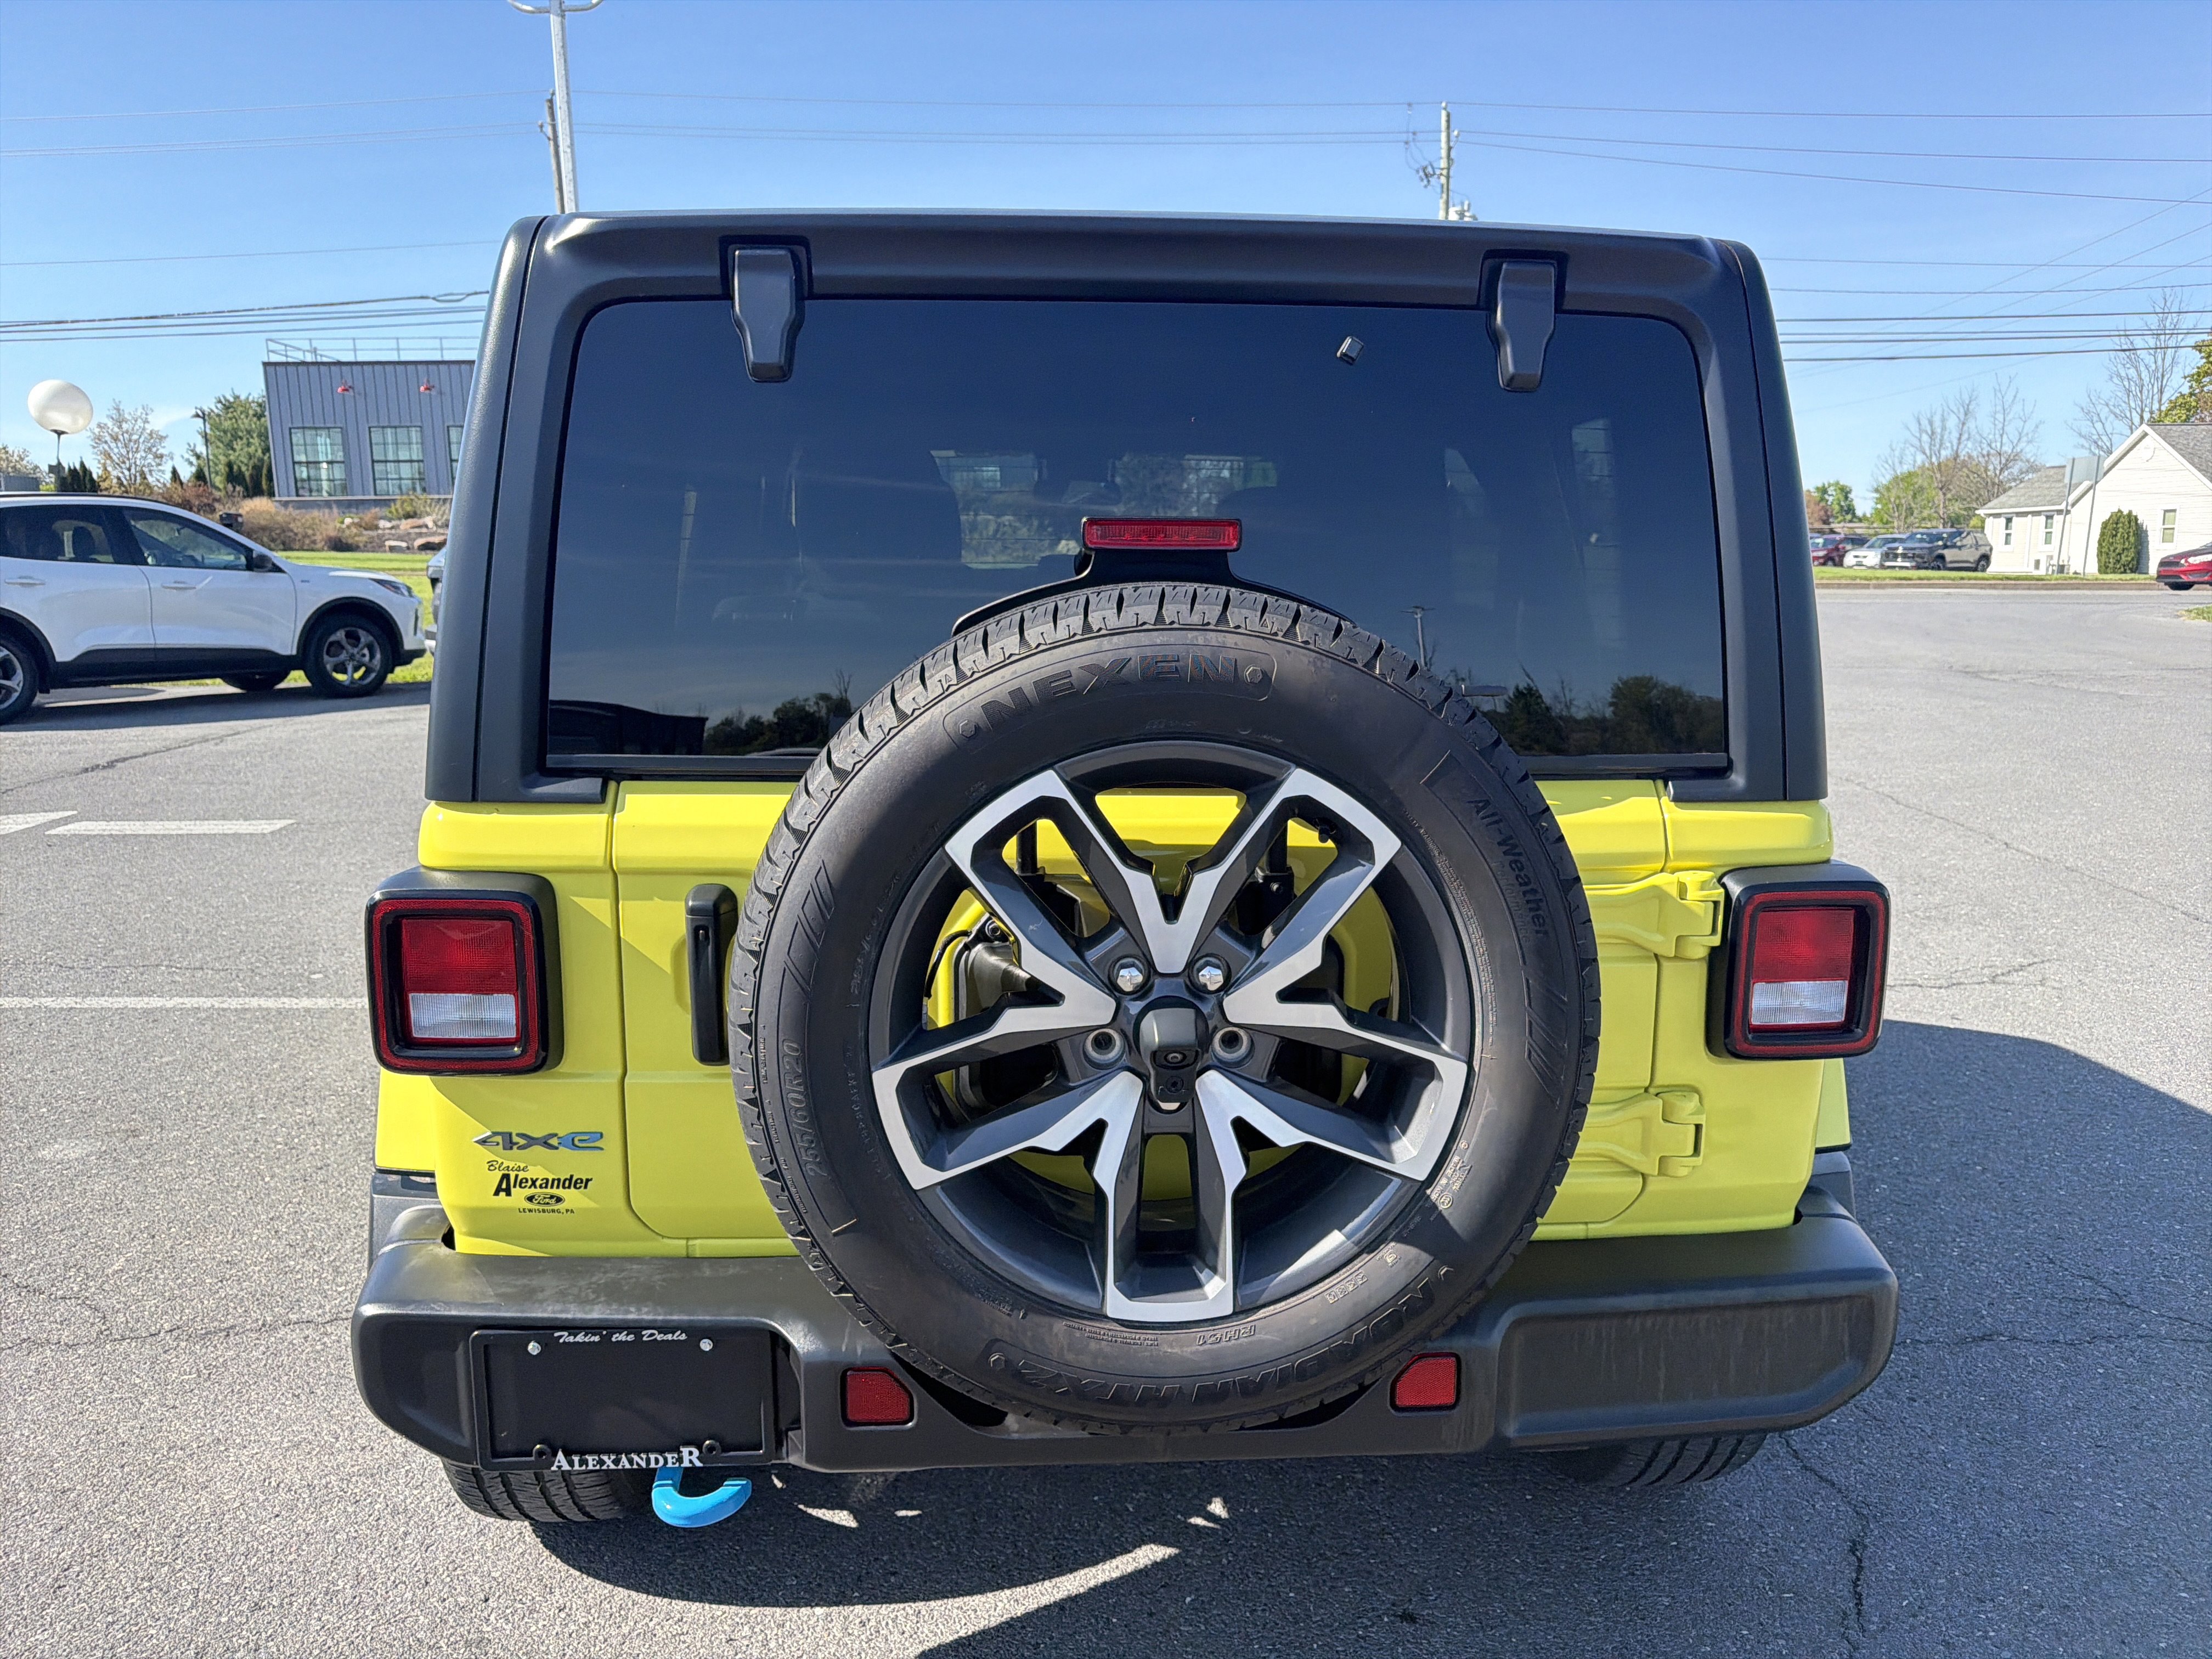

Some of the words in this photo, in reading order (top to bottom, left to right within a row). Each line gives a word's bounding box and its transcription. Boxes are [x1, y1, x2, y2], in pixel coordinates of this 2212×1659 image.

[980, 653, 1236, 731] NEXEN
[1466, 799, 1549, 936] All-Weather
[782, 1039, 828, 1177] 255/60R20
[486, 1160, 529, 1172] Blaise
[492, 1172, 593, 1197] Alexander
[554, 1330, 607, 1343] Takin'
[611, 1331, 635, 1341] the
[641, 1329, 688, 1342] Deals
[1191, 1277, 1435, 1404] ROADIAN
[1015, 1359, 1181, 1404] HTX2
